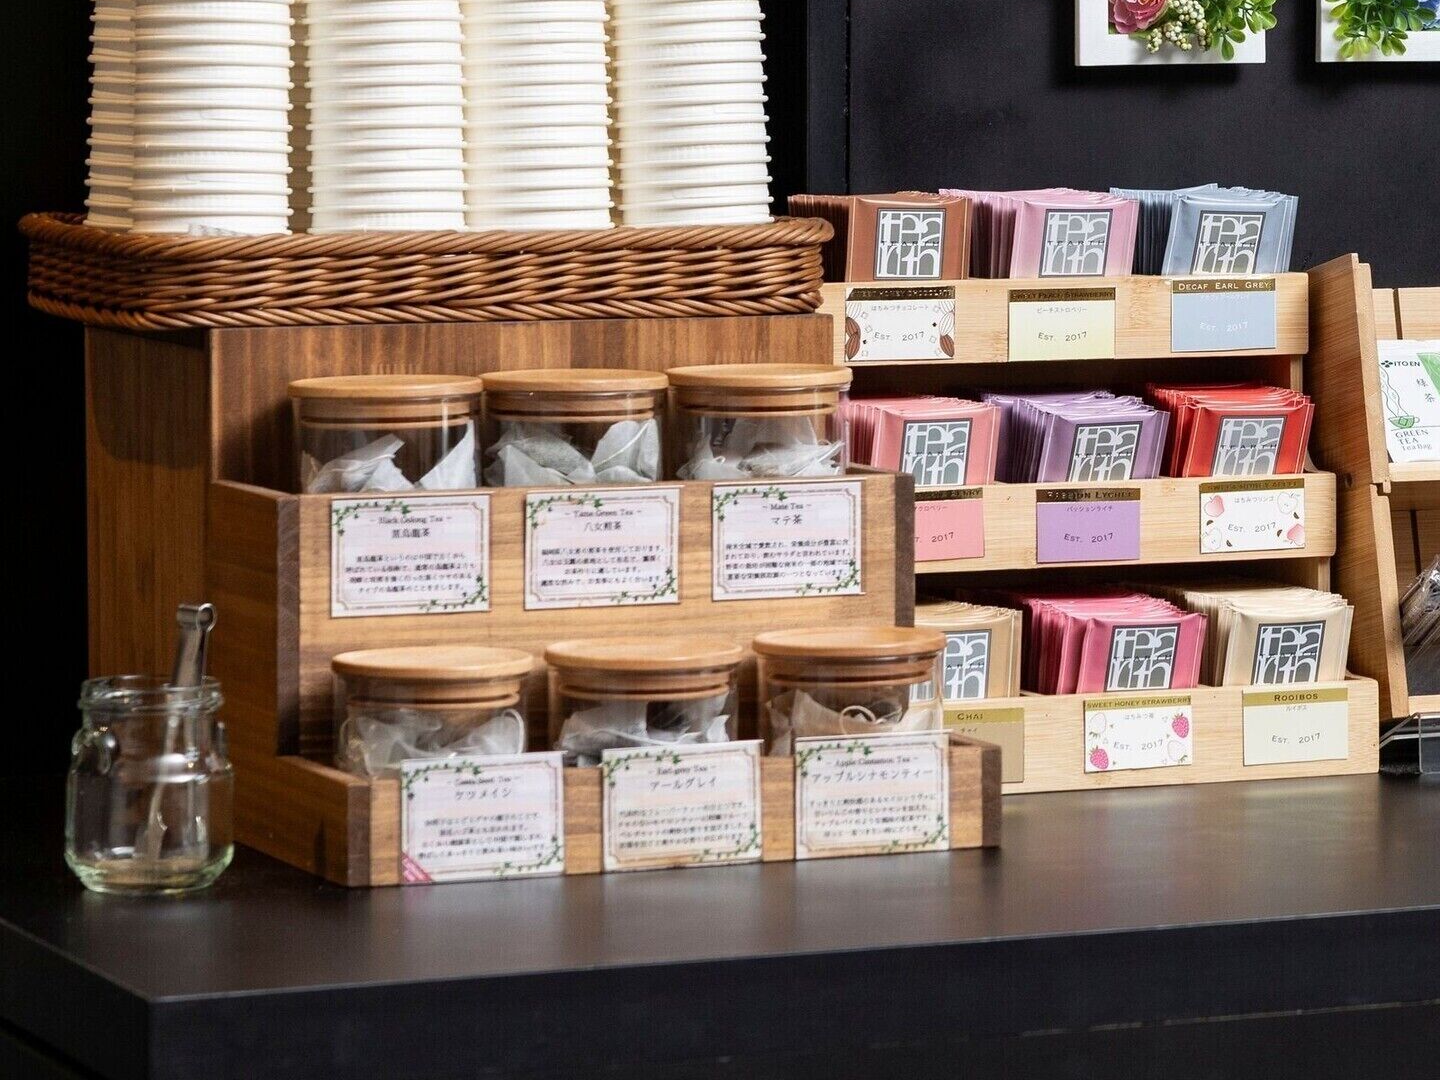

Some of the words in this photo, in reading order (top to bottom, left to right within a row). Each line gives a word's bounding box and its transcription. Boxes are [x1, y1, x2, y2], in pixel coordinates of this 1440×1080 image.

[1178, 283, 1208, 291] DECAF
[1245, 281, 1269, 289] GREY
[1227, 321, 1248, 332] 2017
[902, 331, 925, 342] 2017
[1065, 331, 1088, 342] 2017
[1395, 429, 1429, 438] GREEN
[1399, 437, 1419, 445] TEA
[771, 514, 802, 526] マテ茶
[1254, 522, 1276, 533] 2017
[931, 532, 954, 543] 2017
[1064, 533, 1083, 543] EST.
[1091, 532, 1114, 544] 2017
[945, 635, 987, 667] ea
[1087, 701, 1113, 709] SWEET
[1141, 697, 1192, 706] STRAWBERRY
[1274, 693, 1318, 702] ROOIBOS
[957, 712, 984, 721] CHAI
[1299, 733, 1321, 744] 2017
[1141, 739, 1163, 751] 2017
[811, 769, 934, 783] アップルシナモンティー
[650, 776, 717, 790] アールグレイ
